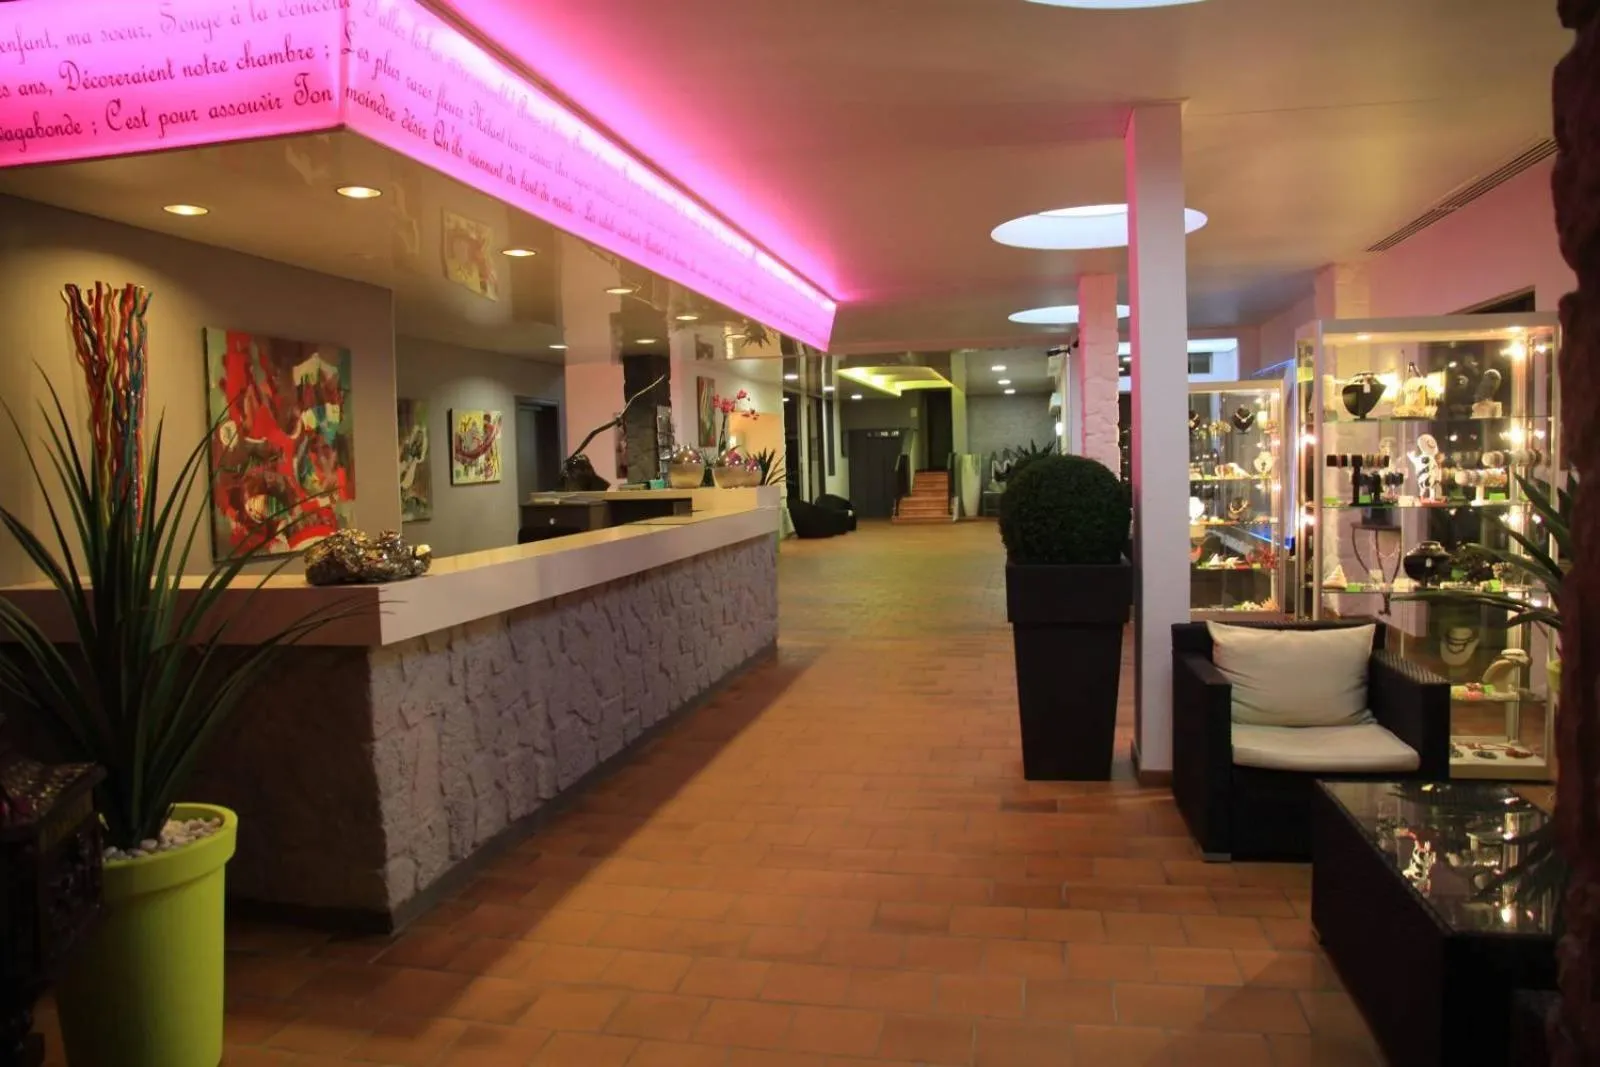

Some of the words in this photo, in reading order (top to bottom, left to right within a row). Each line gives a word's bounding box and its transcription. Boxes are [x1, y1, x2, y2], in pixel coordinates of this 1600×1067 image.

[66, 31, 93, 46] ma
[159, 2, 223, 43] Songe
[230, 5, 241, 26] à
[249, 1, 269, 23] la
[18, 81, 53, 97] ans,
[58, 60, 176, 92] Décoreraient
[182, 53, 229, 78] notre
[236, 33, 315, 70] chambre
[341, 20, 370, 62] Les
[371, 49, 400, 80] plus
[158, 108, 199, 139] pour
[208, 92, 284, 119] assouvir
[294, 72, 333, 106] Ton
[345, 85, 397, 122] moindre
[401, 107, 428, 140] désir
